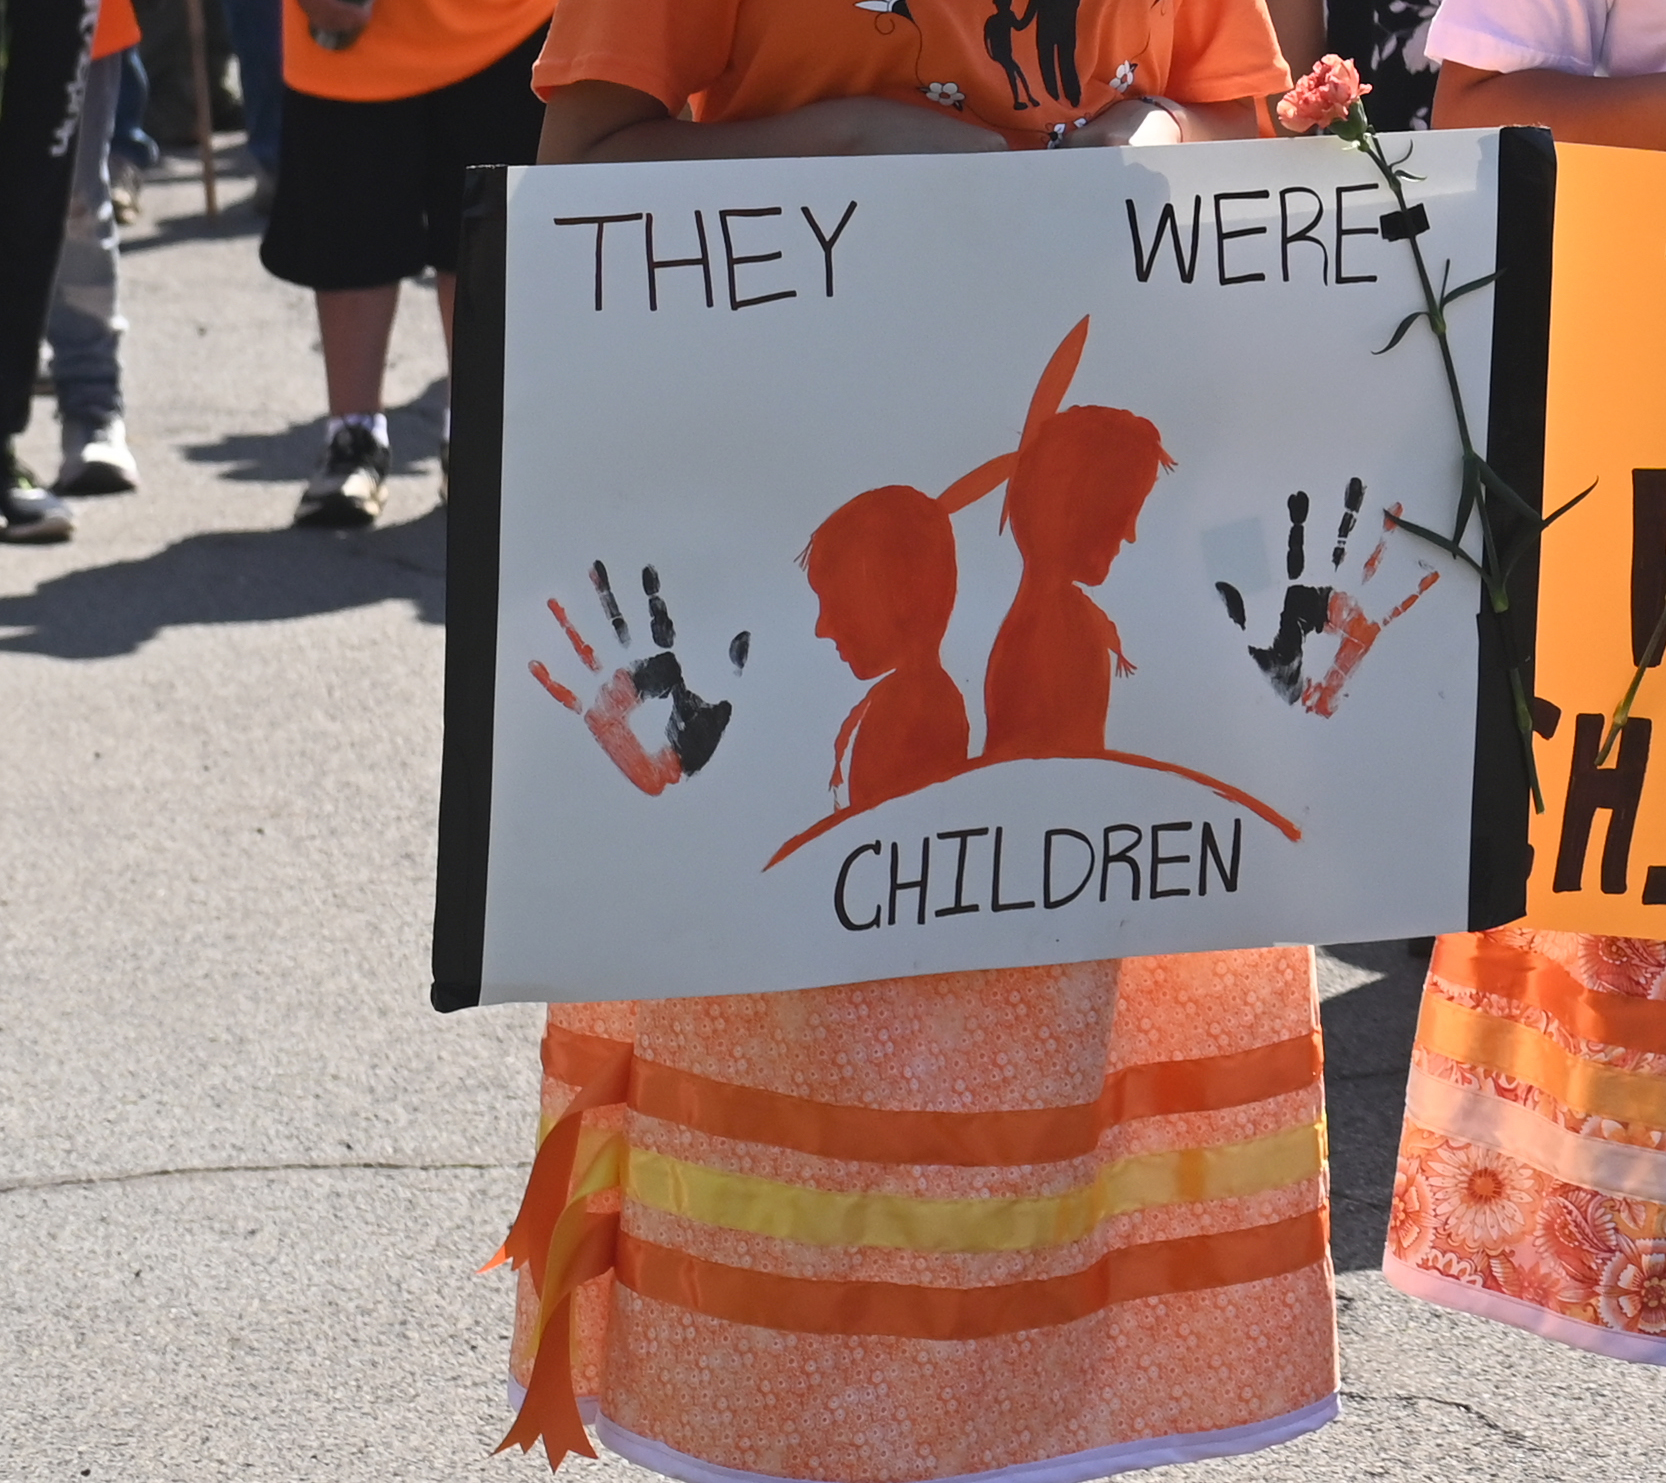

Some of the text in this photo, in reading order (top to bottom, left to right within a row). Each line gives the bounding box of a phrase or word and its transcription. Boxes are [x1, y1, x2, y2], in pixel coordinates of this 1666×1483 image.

[554, 183, 1379, 312] THEY WERE
[834, 817, 1242, 932] CHILDREN
